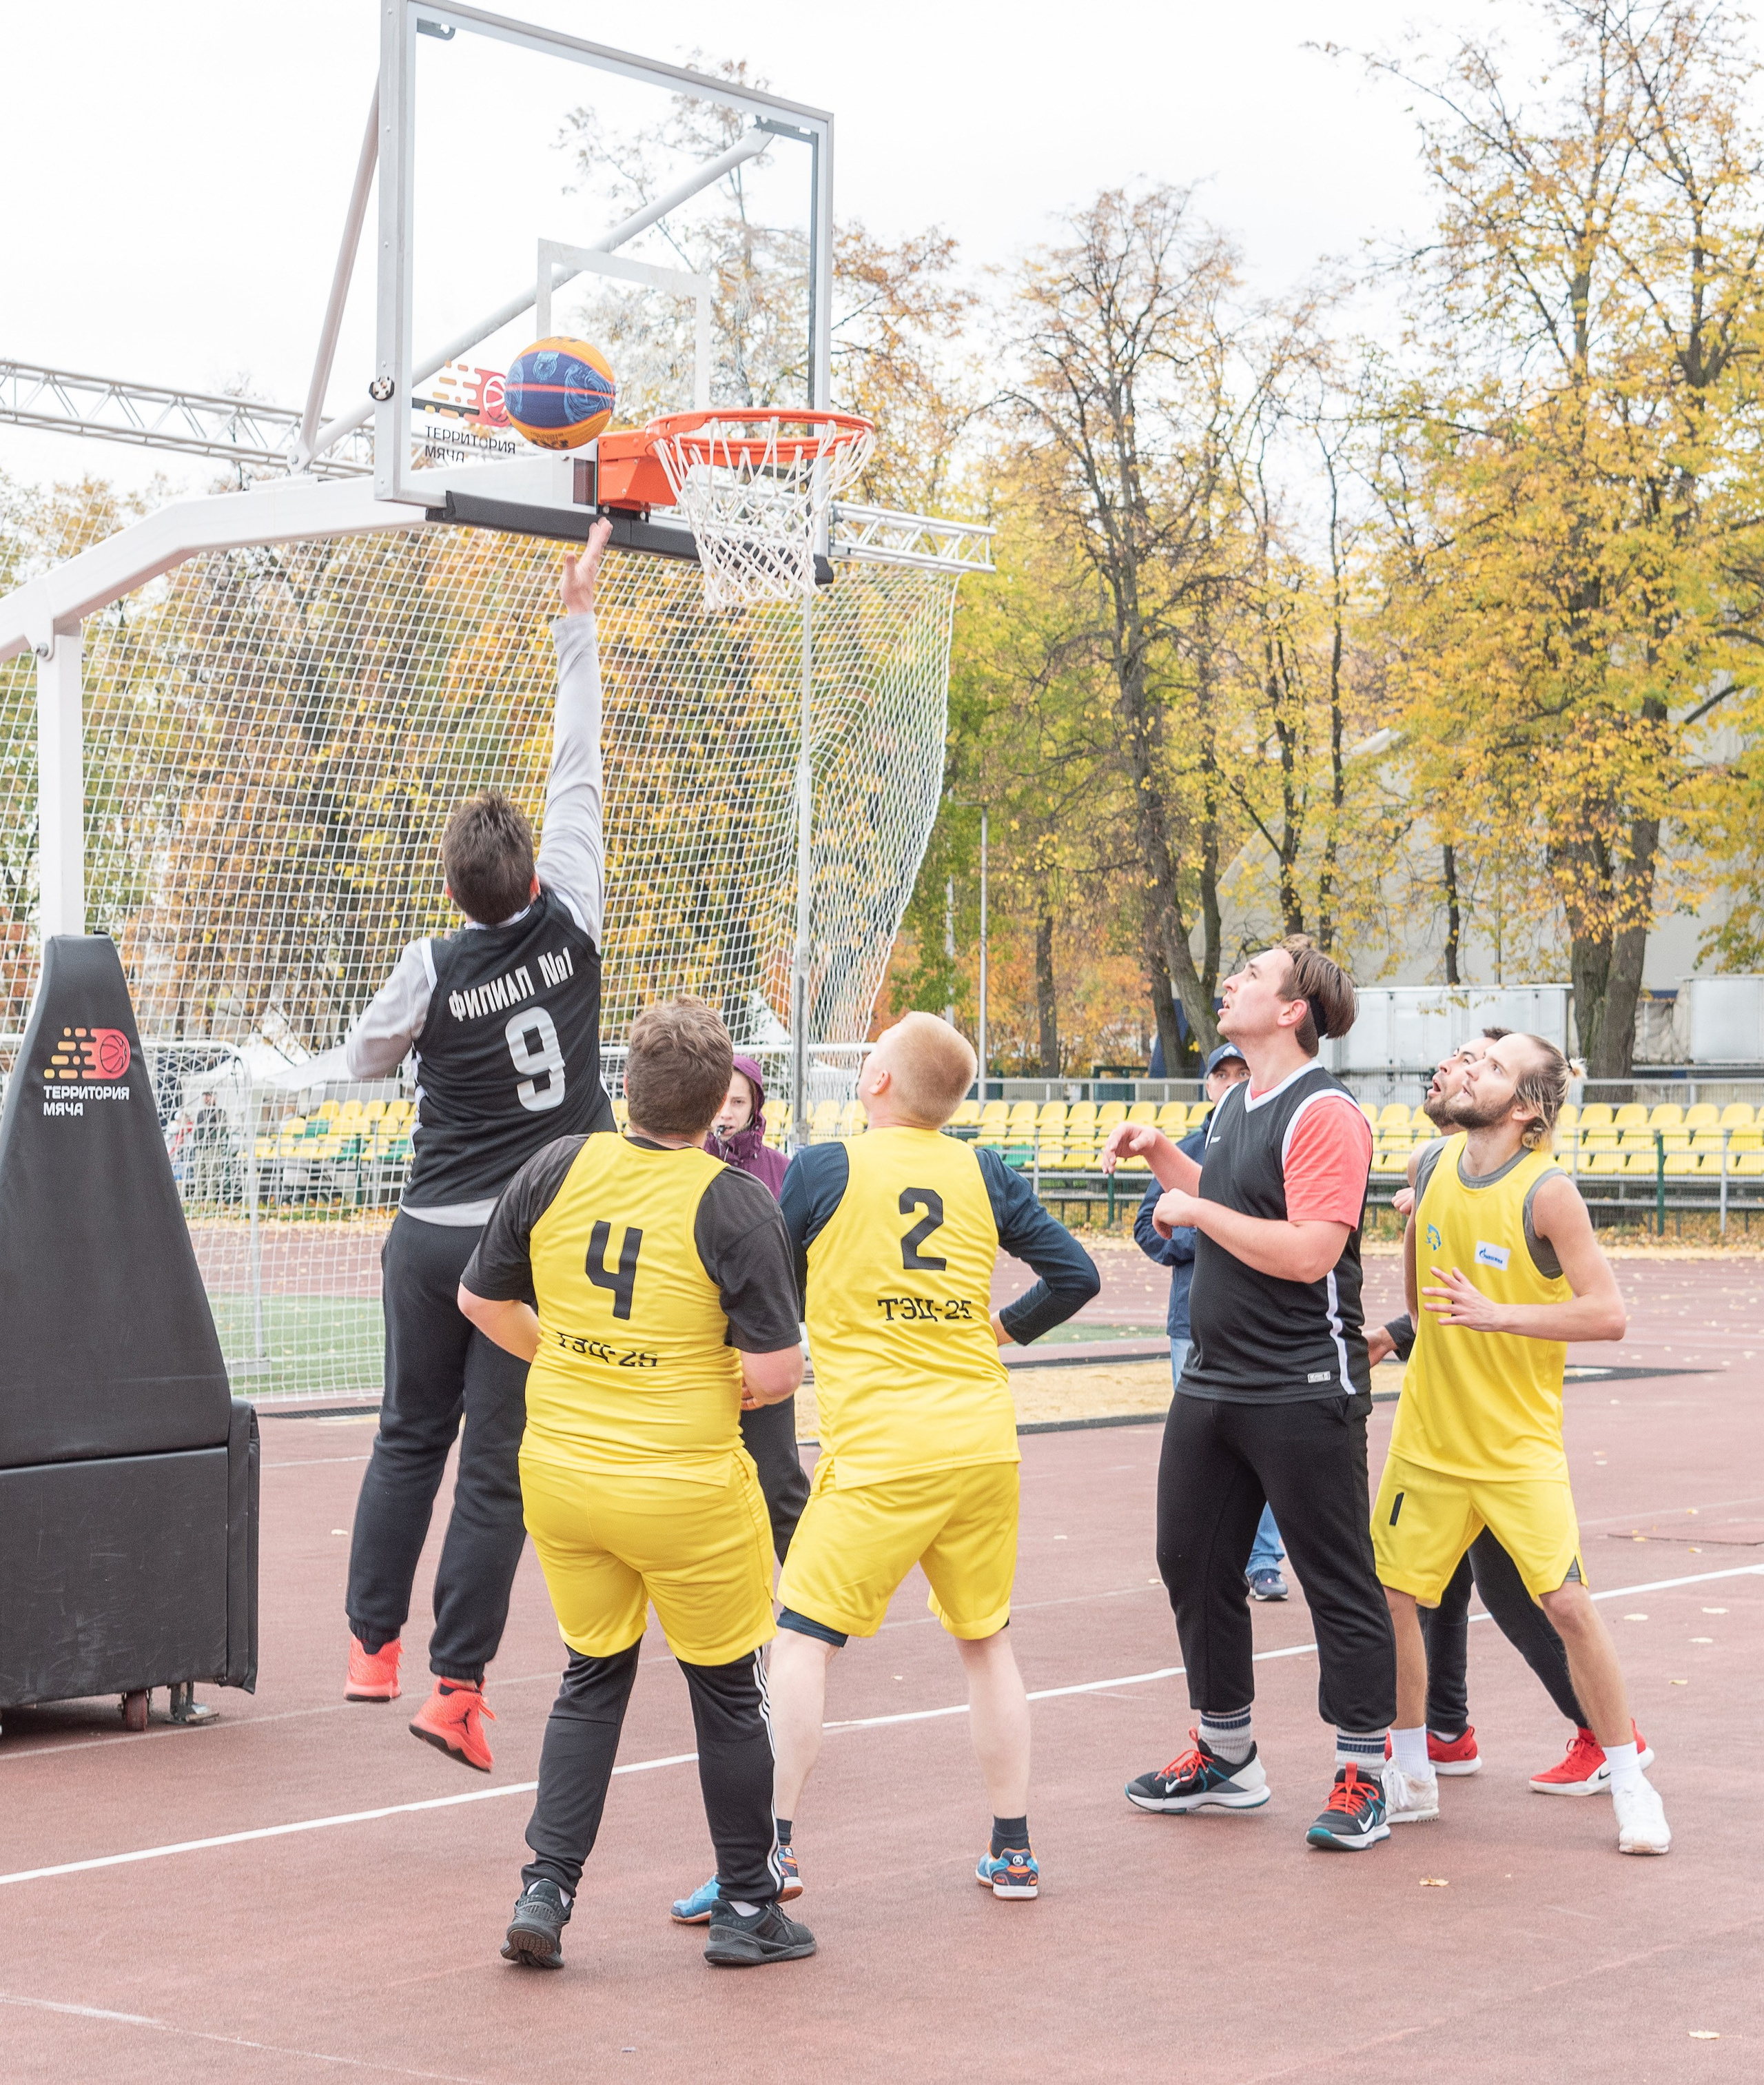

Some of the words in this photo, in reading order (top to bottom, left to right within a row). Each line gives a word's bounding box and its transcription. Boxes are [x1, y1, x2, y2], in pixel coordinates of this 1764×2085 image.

[448, 965, 535, 1022] ФИЛИАЛ
[504, 1006, 566, 1112] 9
[43, 1085, 130, 1101] ТЕРРИТОРИЯ
[43, 1102, 84, 1116] МЯЧА
[899, 1187, 947, 1271] 2
[585, 1220, 643, 1321] 4
[877, 1297, 972, 1321] ТЭЦ-25
[1389, 1492, 1404, 1527] 1
